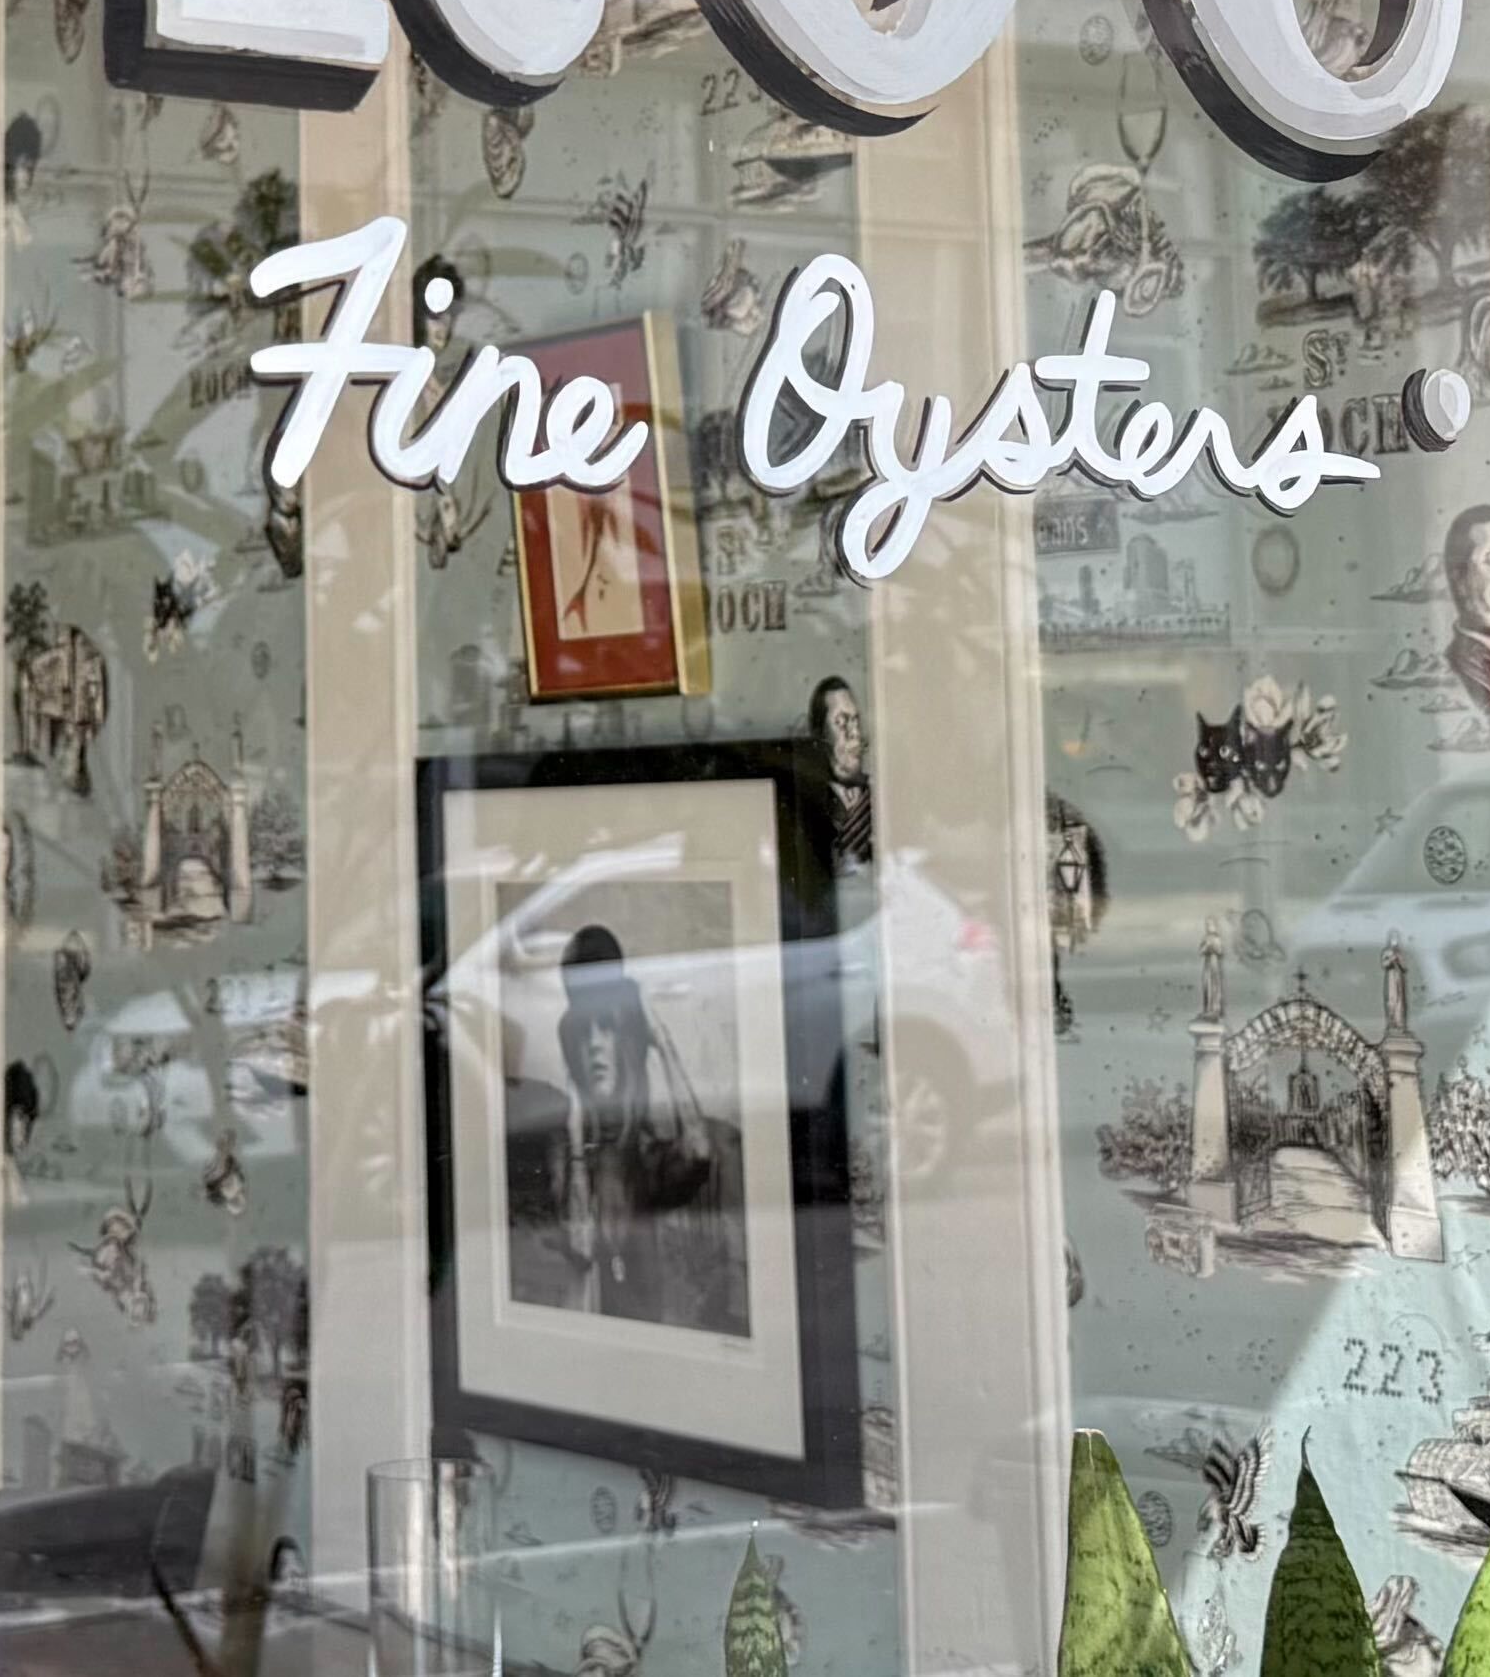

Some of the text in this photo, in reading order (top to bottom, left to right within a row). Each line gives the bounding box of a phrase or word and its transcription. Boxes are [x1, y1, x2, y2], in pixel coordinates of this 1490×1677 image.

[249, 215, 650, 491] Fine
[740, 253, 1383, 583] Oysters
[1342, 1338, 1444, 1405] 223
